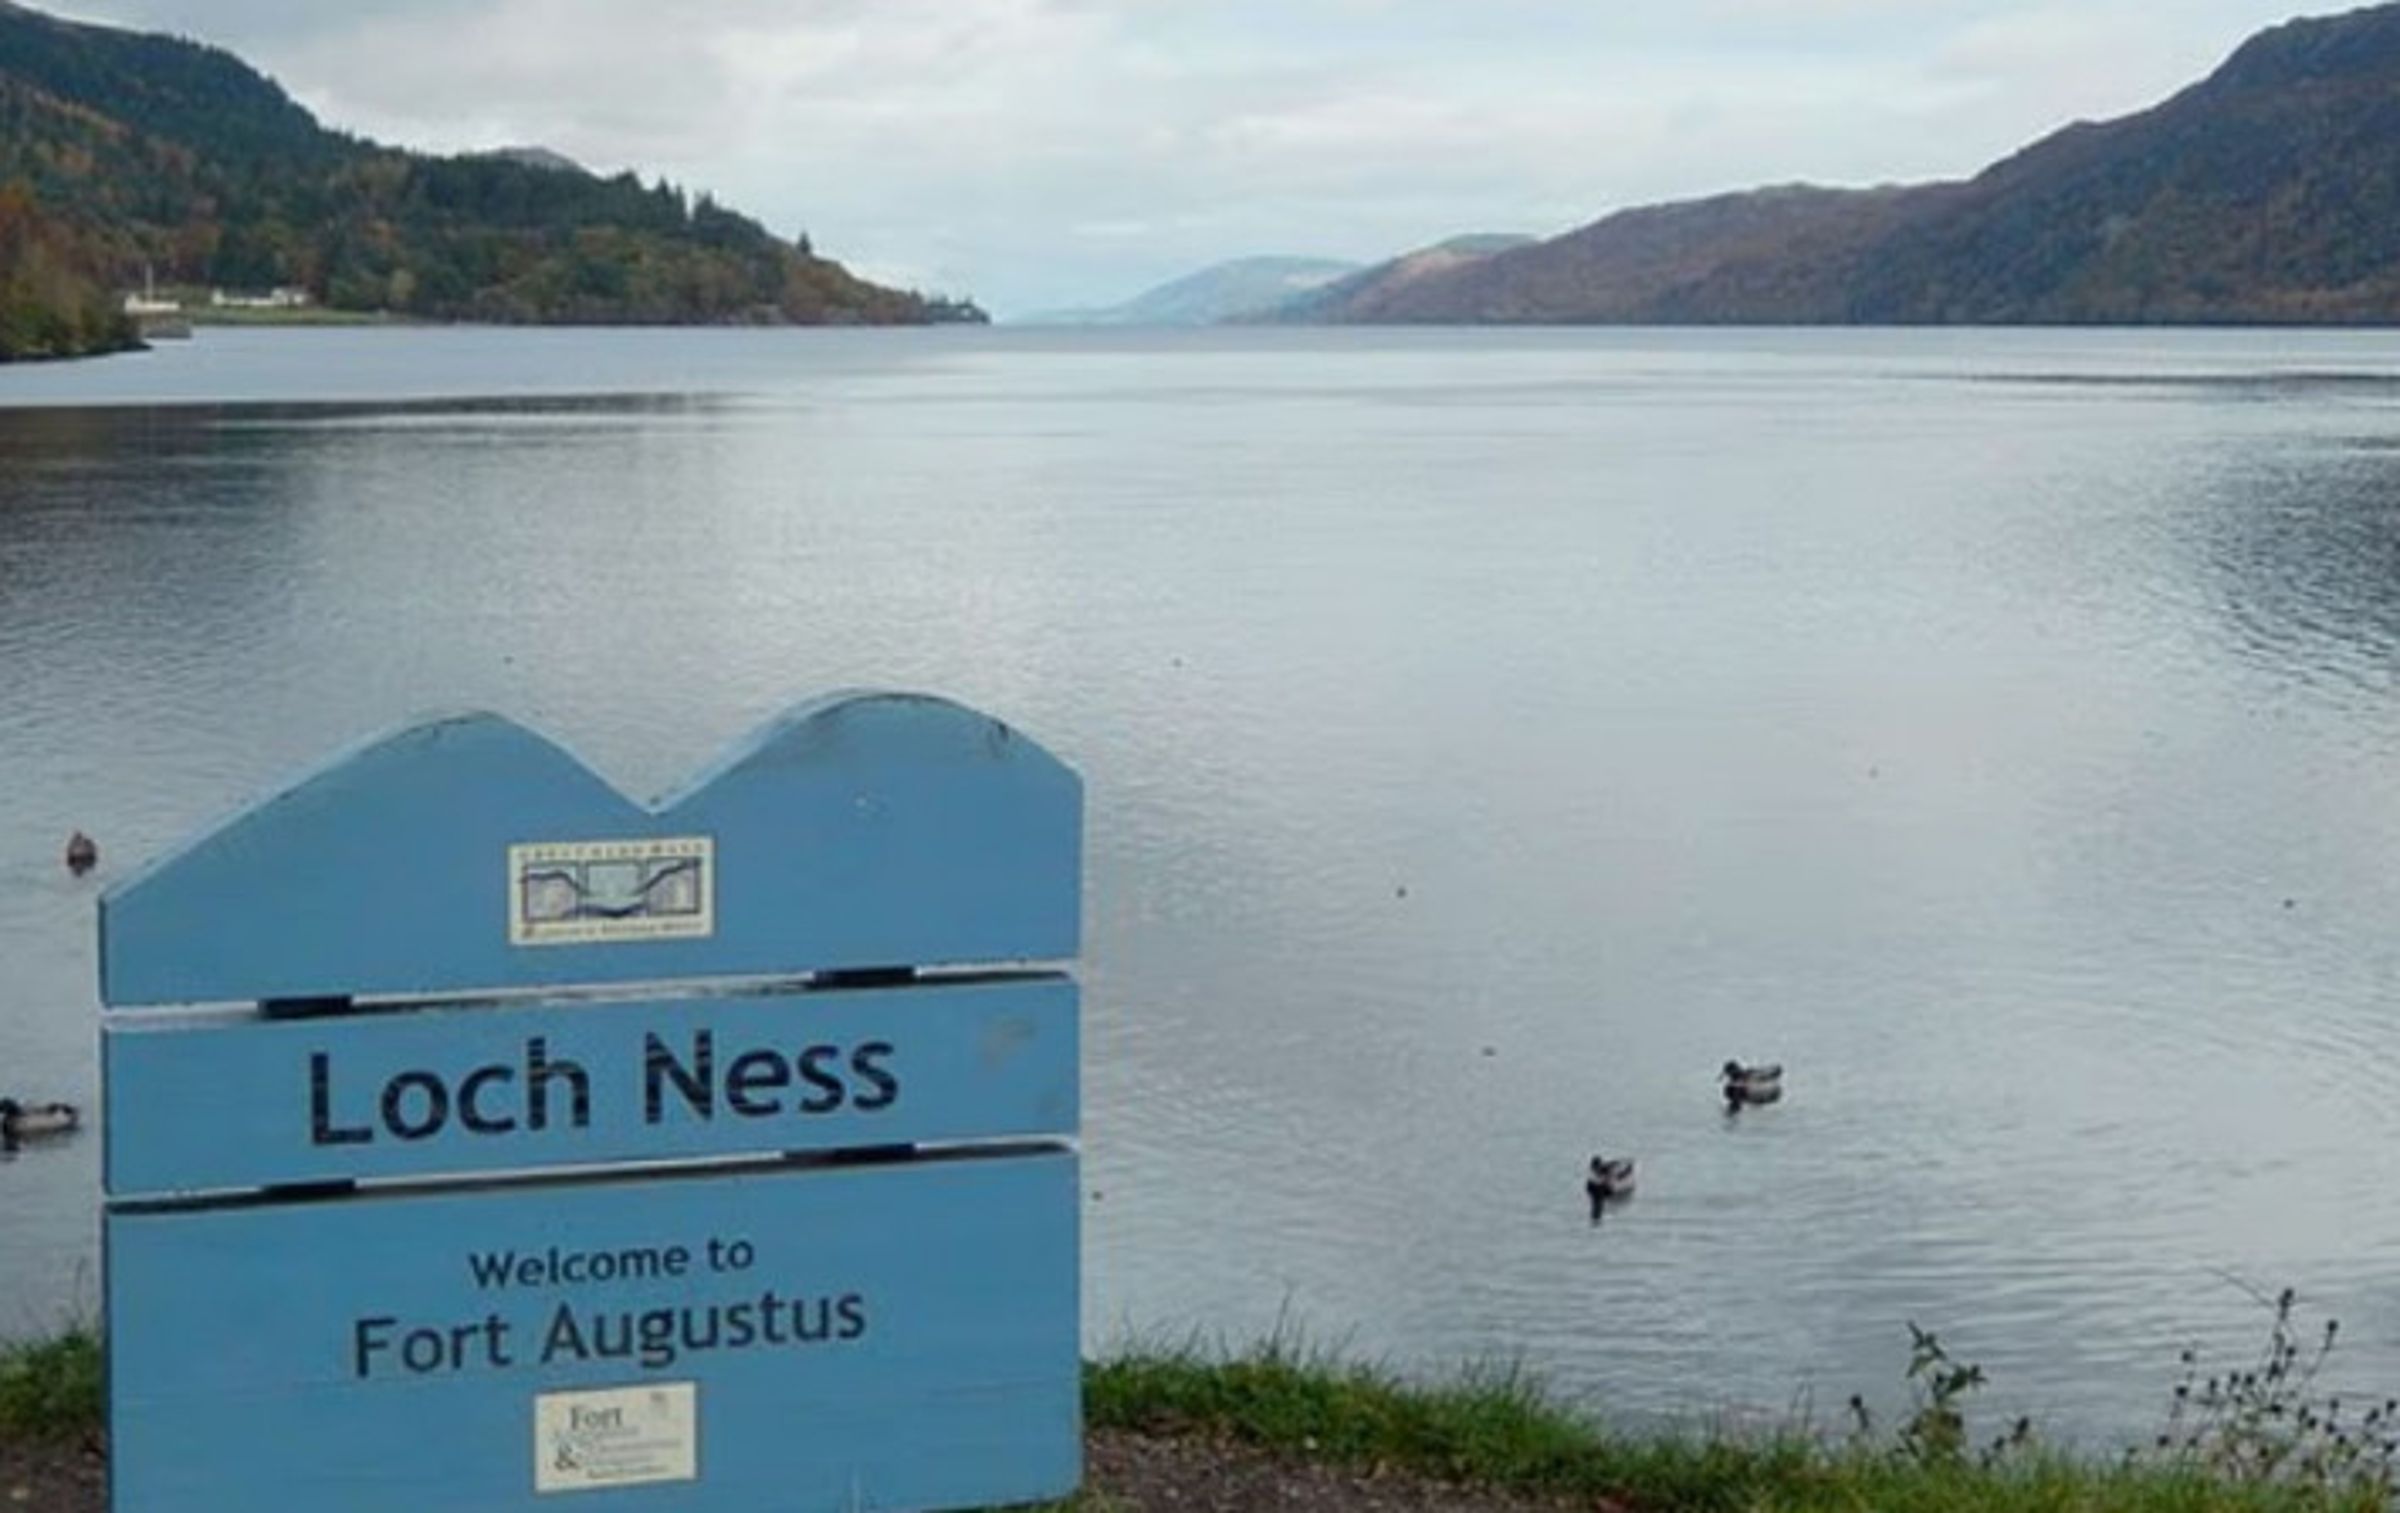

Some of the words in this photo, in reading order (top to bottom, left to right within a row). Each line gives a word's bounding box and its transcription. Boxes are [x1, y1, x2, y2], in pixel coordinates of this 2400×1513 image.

[310, 1036, 591, 1145] Loch
[644, 1029, 899, 1125] Ness
[470, 1244, 690, 1289] Welcome
[708, 1238, 754, 1272] to
[355, 1313, 512, 1378] Fort
[541, 1291, 867, 1369] Augustus
[570, 1406, 623, 1431] Fort
